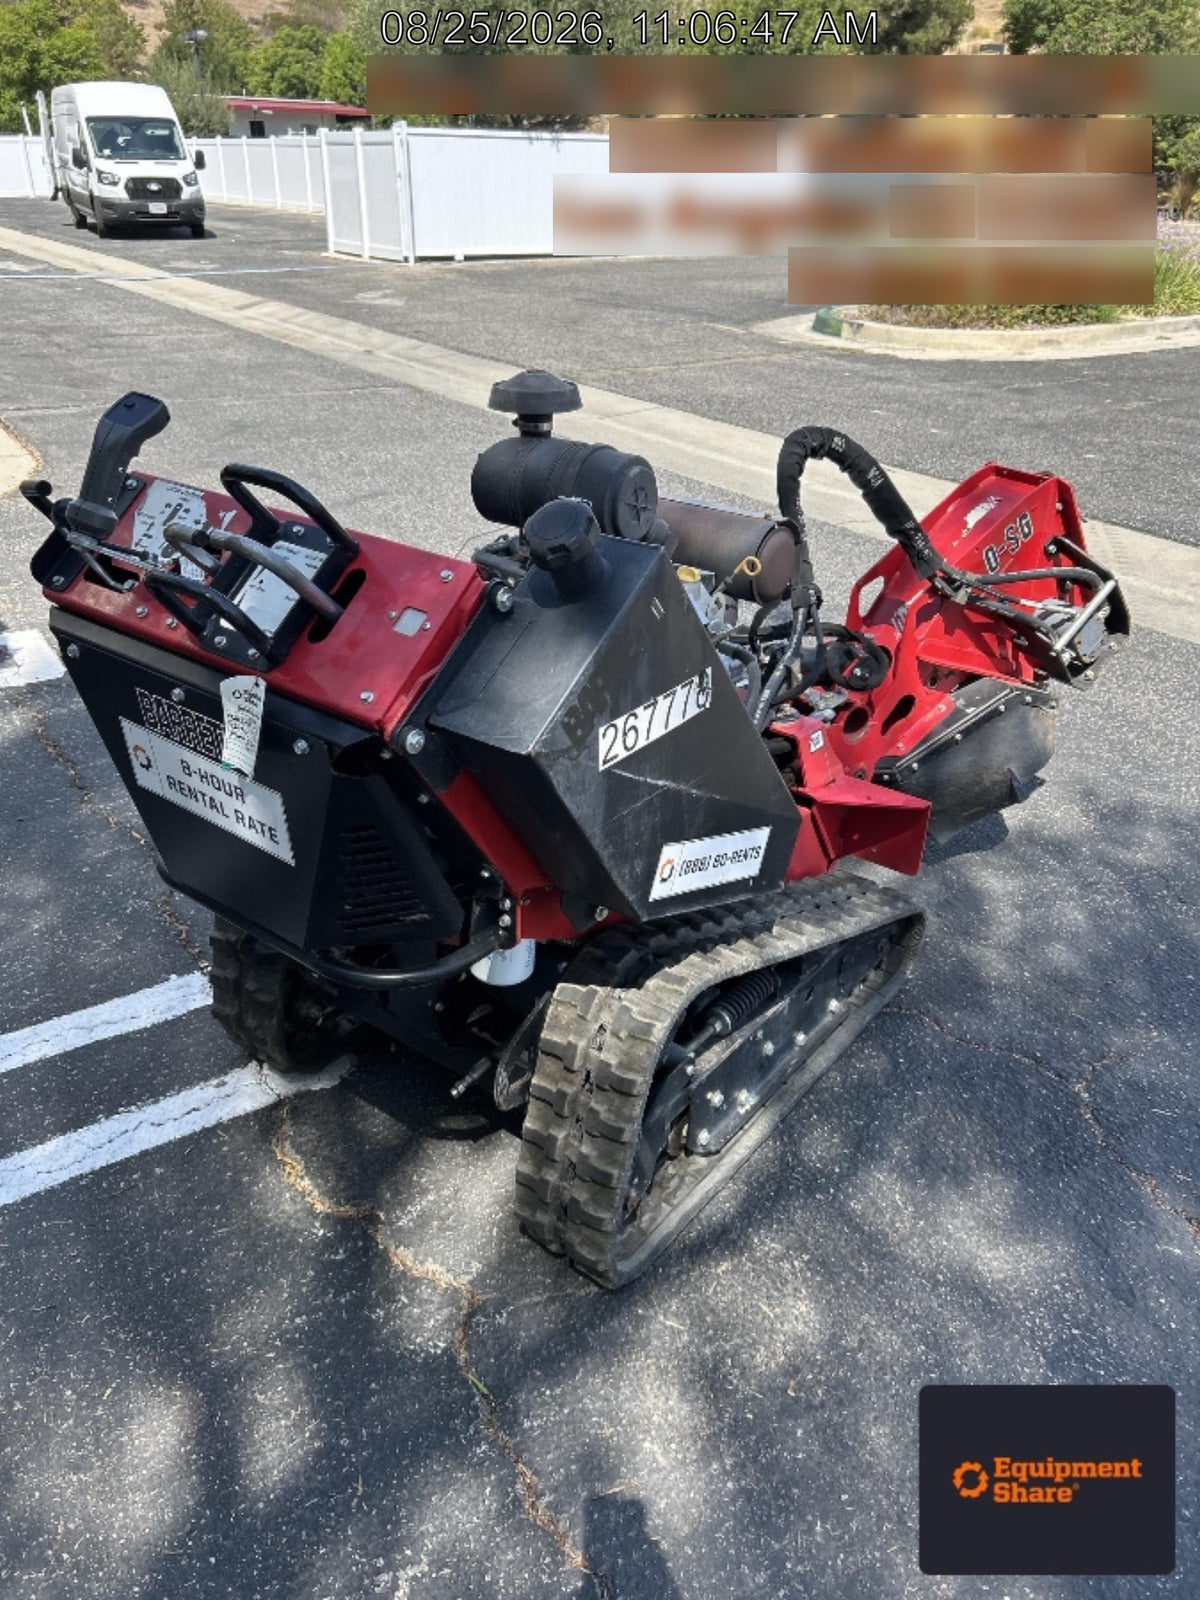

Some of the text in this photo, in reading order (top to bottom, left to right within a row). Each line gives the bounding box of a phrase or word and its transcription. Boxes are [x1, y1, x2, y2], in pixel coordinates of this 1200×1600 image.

[135, 686, 225, 762] BARRET
[166, 775, 280, 845] RENTAL RATE
[180, 758, 246, 804] 8-HOUR
[678, 854, 712, 877] (888)
